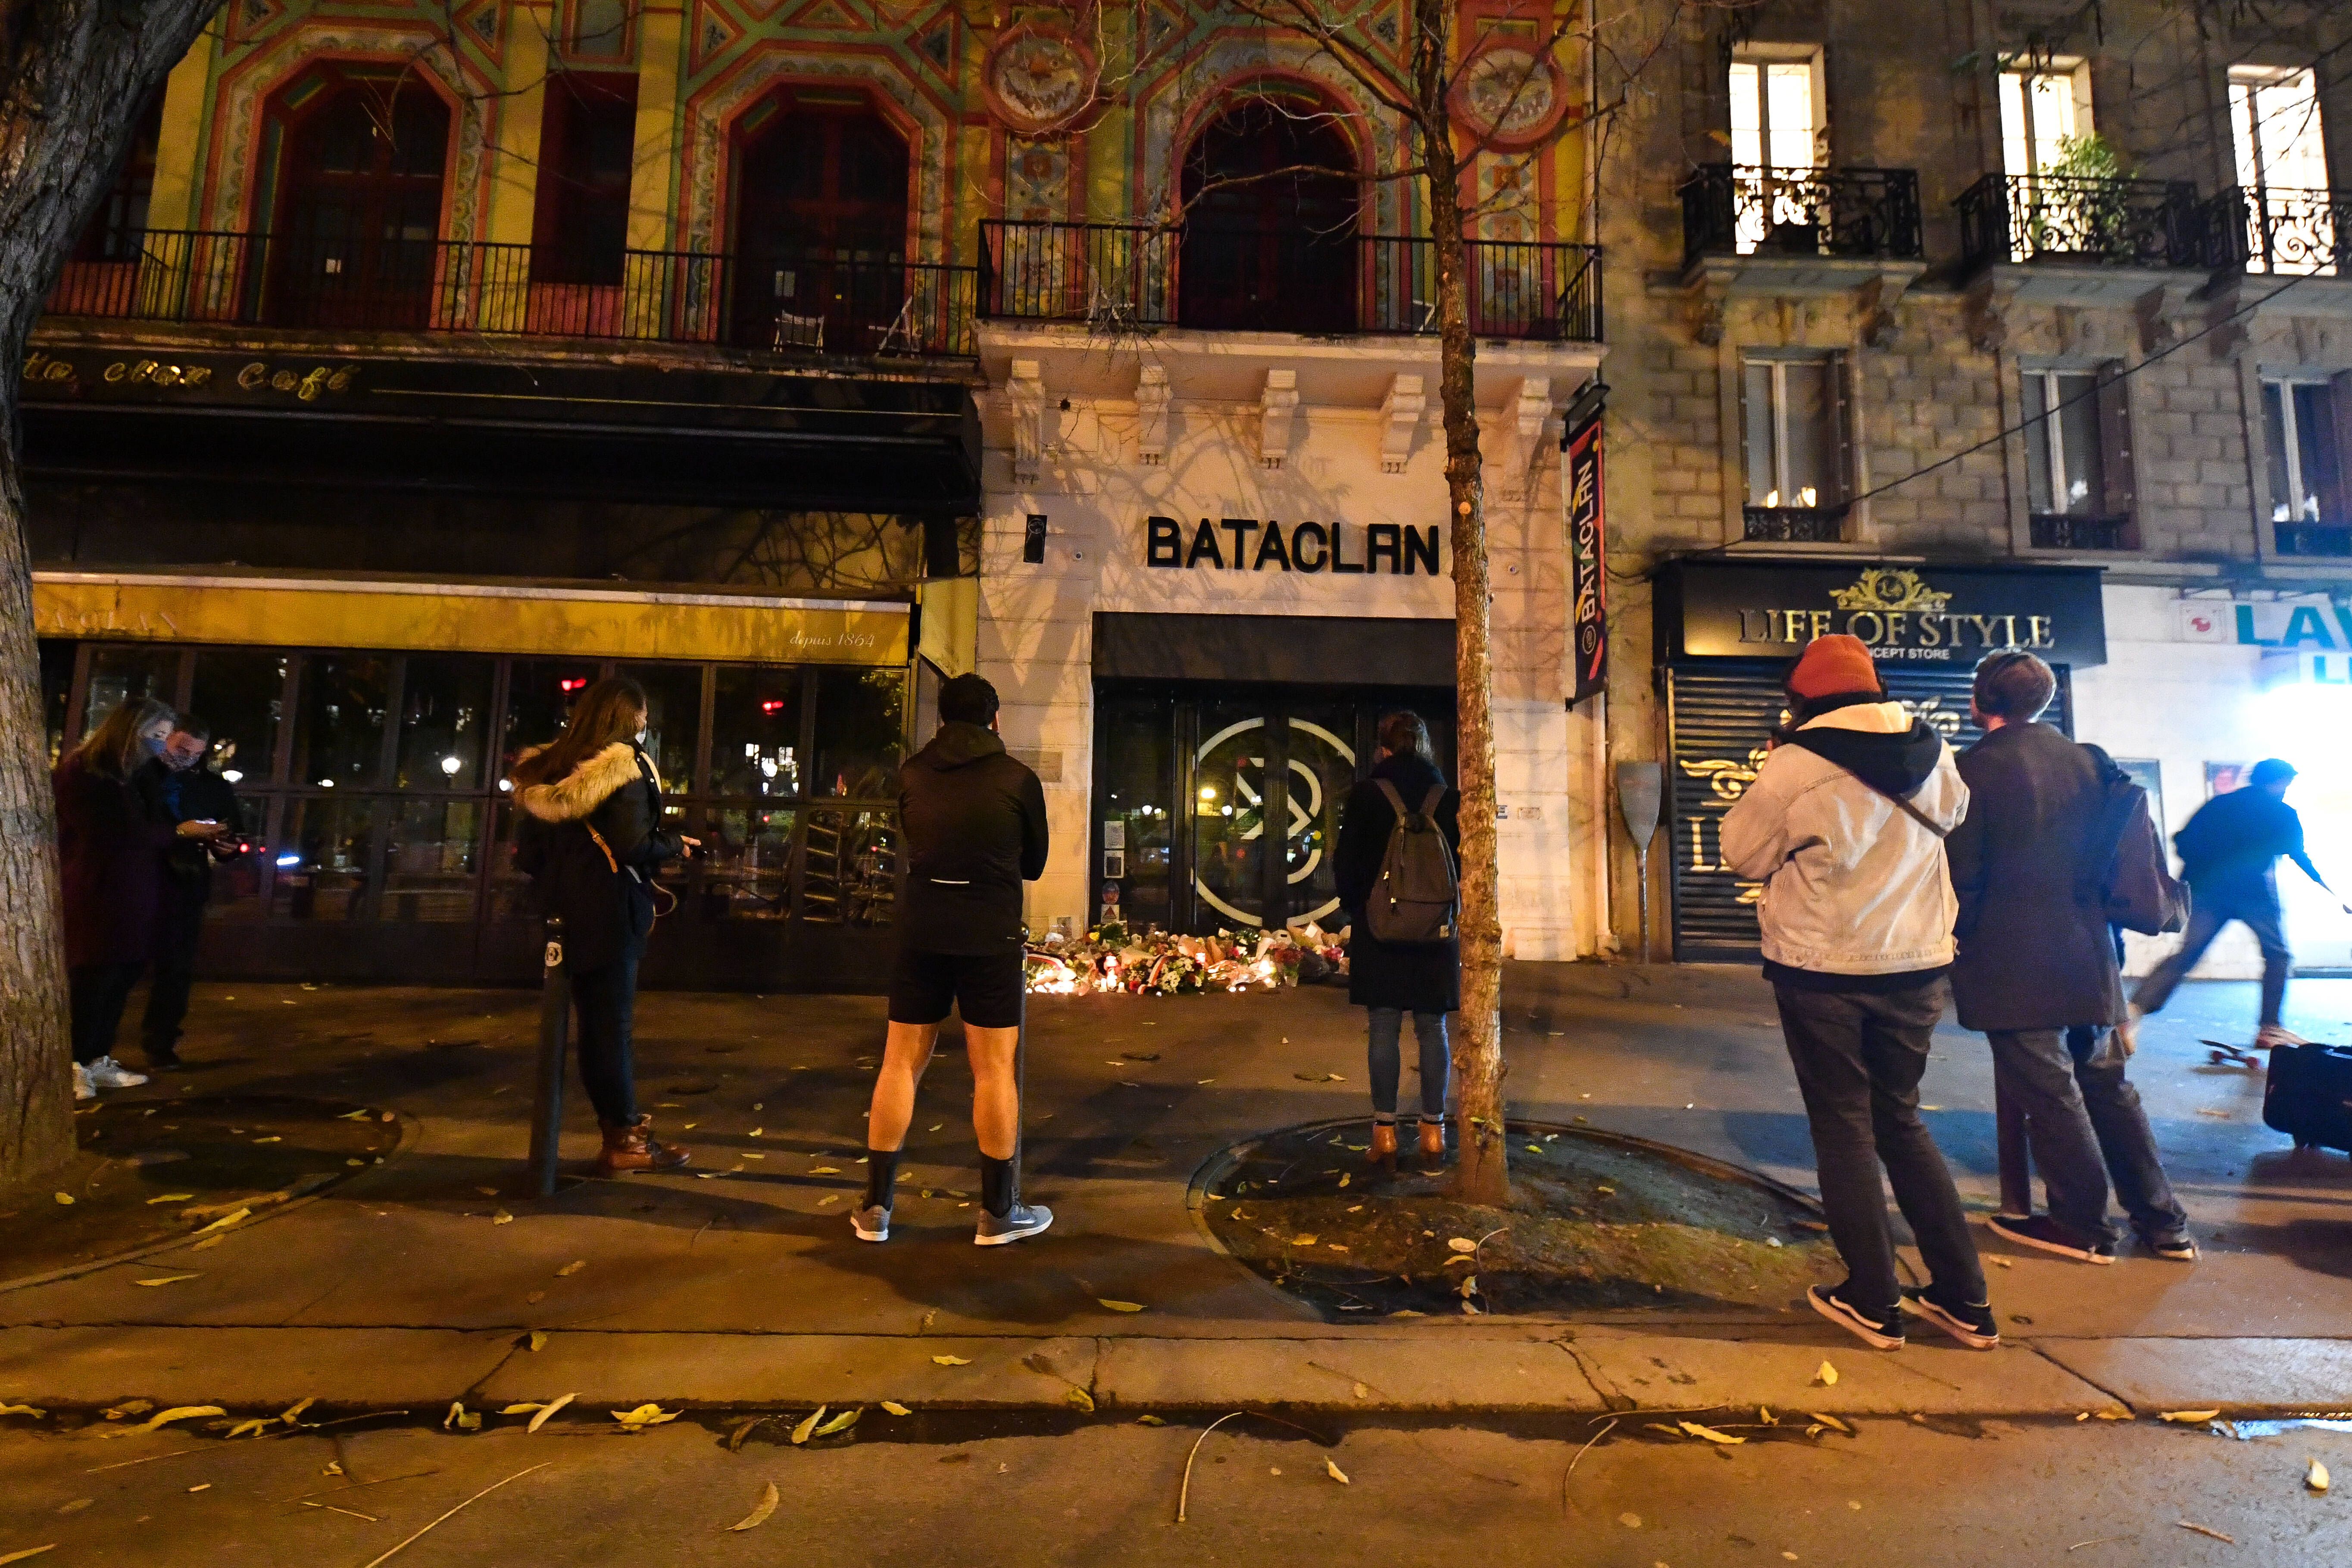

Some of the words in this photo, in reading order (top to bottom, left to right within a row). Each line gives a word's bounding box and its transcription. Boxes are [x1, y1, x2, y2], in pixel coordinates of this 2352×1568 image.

[1147, 515, 1440, 575] BATACLAN
[1578, 459, 1595, 623] BATACLAN
[790, 630, 831, 649] depuis
[838, 633, 875, 647] 1864
[1739, 609, 1832, 643] LIFE
[1846, 611, 1907, 646] OF
[1919, 611, 2055, 648] STYLE
[1869, 647, 1905, 659] NCEPT
[1908, 648, 1950, 660] STORE
